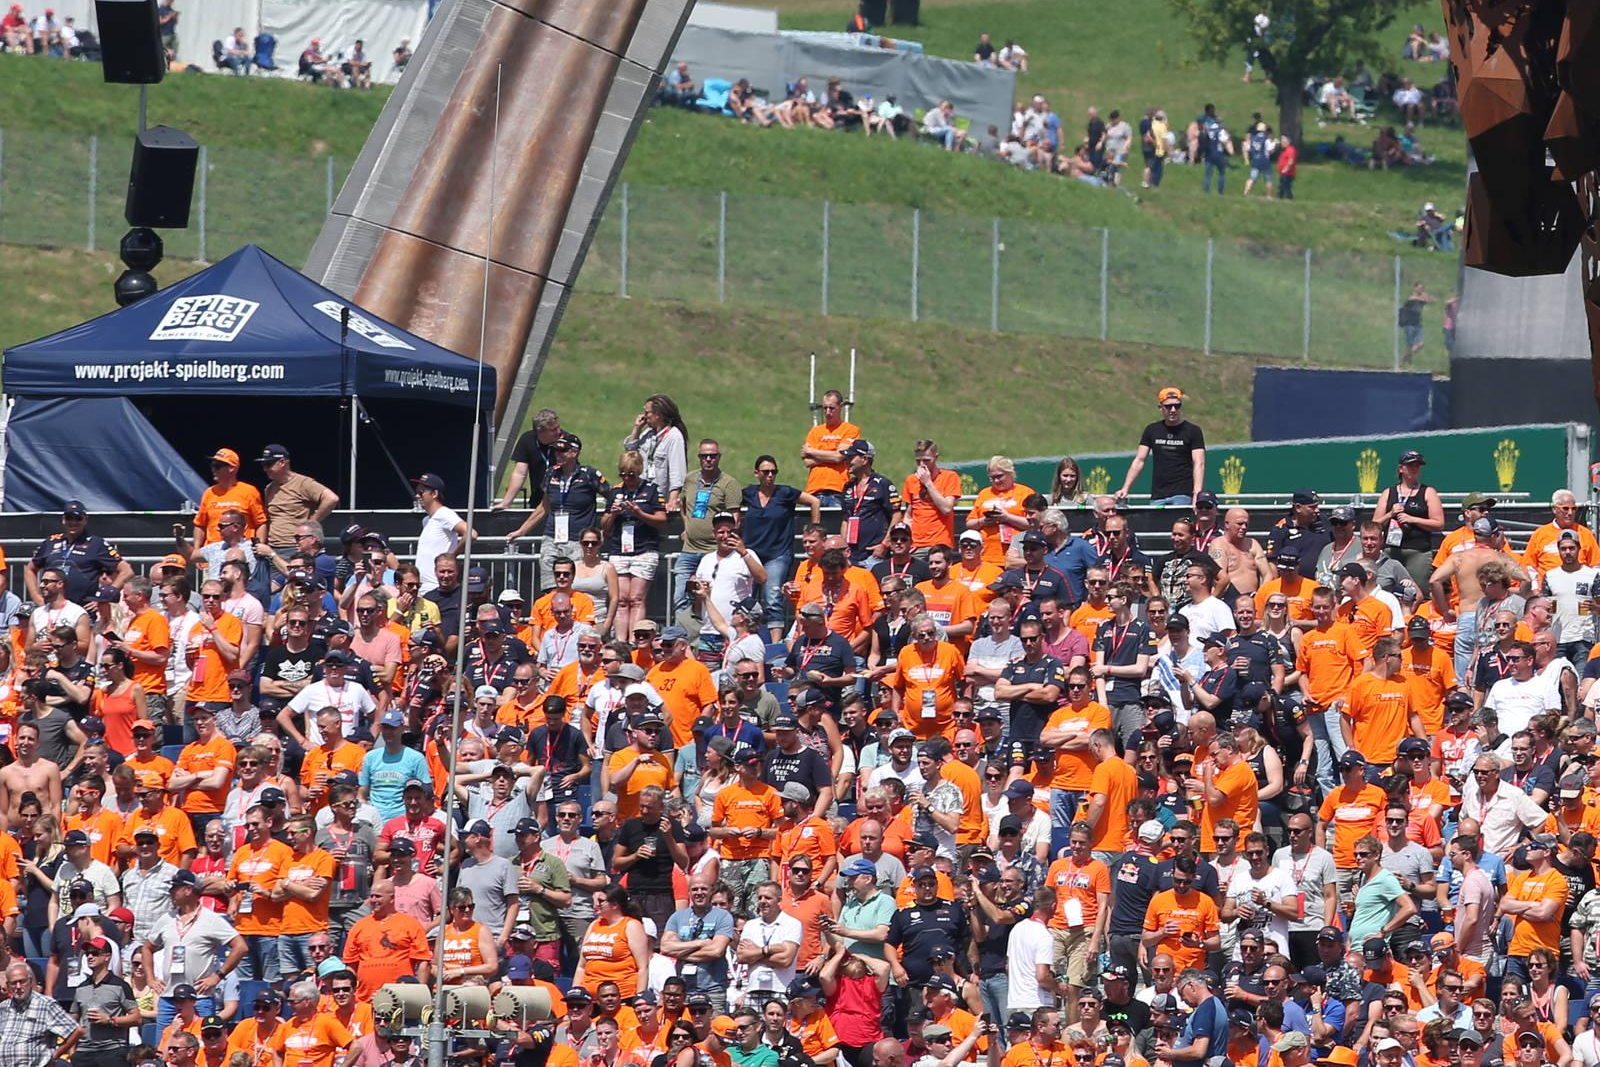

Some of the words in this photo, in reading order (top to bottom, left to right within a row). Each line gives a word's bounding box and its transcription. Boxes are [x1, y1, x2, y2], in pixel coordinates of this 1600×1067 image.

[173, 296, 251, 318] SPIEL
[167, 310, 238, 330] BERG
[74, 360, 285, 383] www.projekt-spielberg.com
[659, 678, 676, 691] 33
